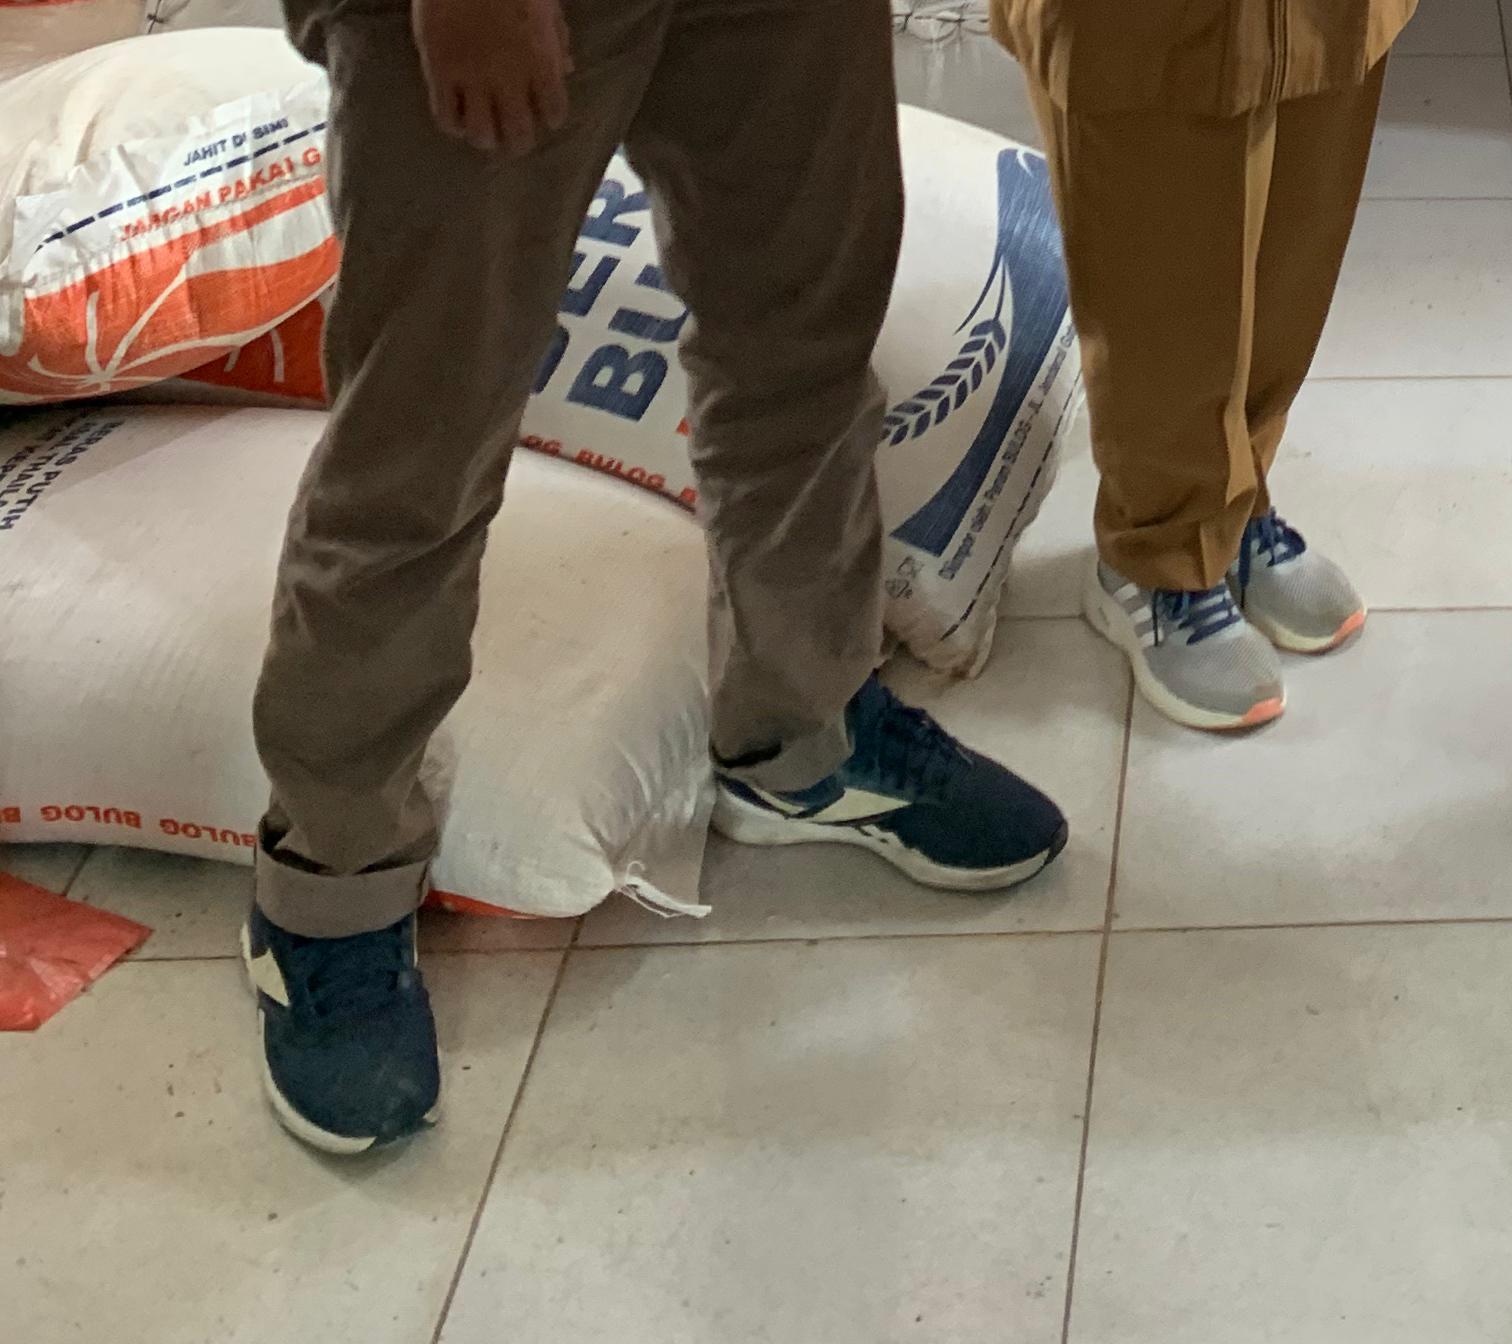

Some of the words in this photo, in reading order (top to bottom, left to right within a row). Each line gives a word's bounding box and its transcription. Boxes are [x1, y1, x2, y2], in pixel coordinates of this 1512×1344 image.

[184, 138, 228, 166] JAHIT
[218, 156, 294, 204] PAKAI
[40, 805, 142, 829] BULOG
